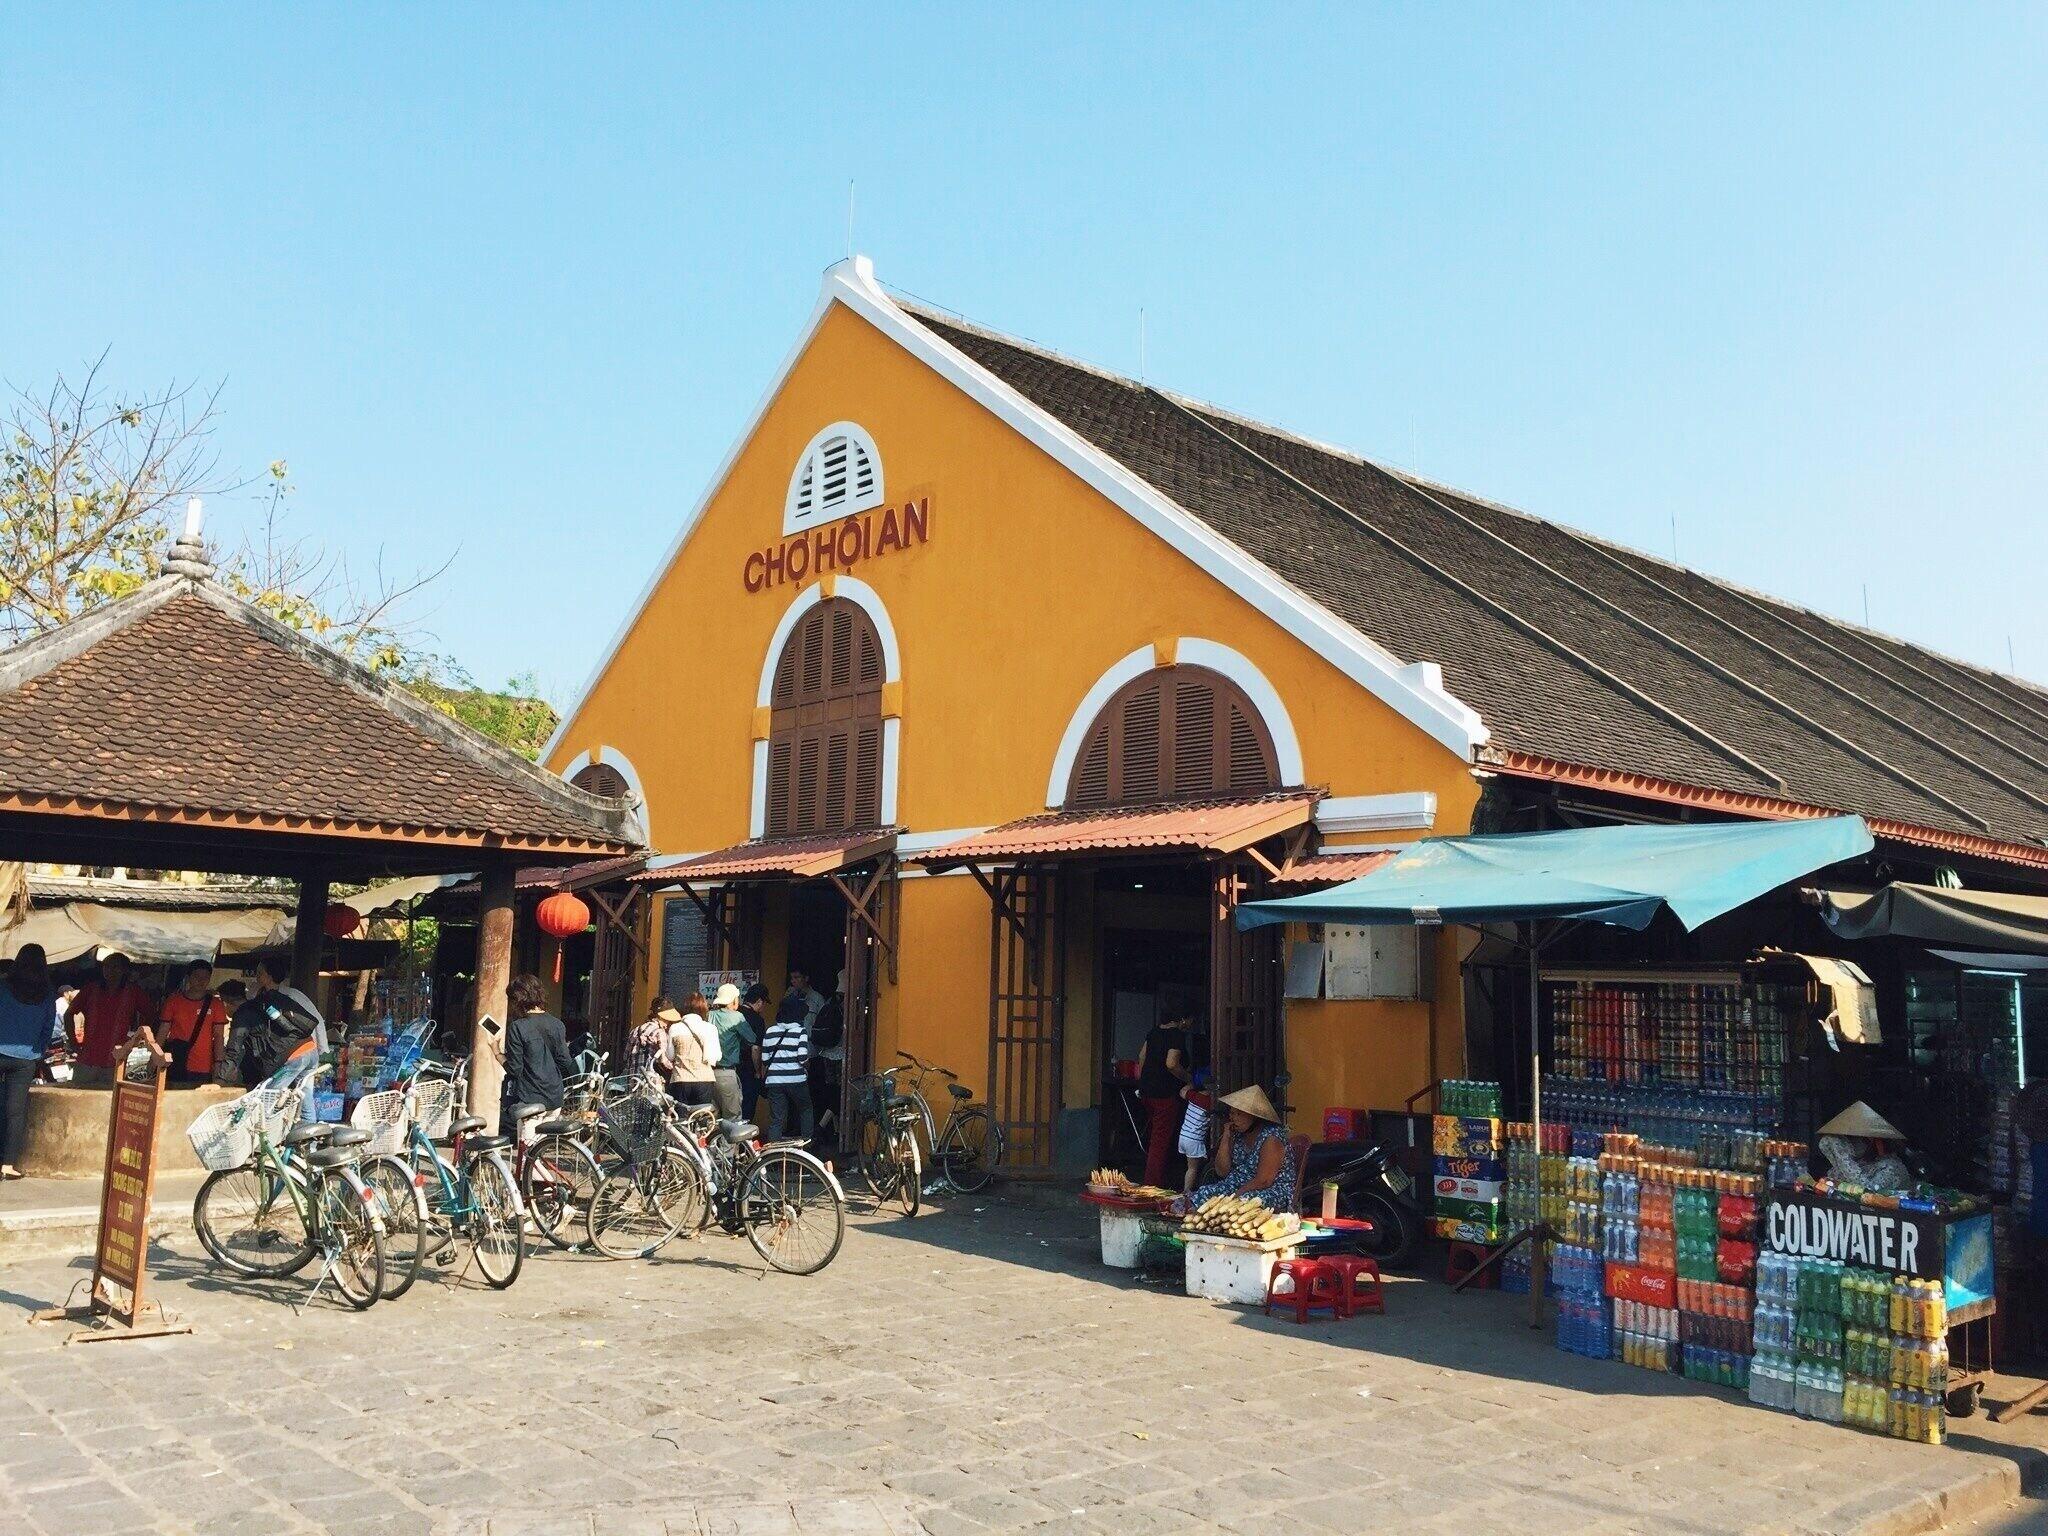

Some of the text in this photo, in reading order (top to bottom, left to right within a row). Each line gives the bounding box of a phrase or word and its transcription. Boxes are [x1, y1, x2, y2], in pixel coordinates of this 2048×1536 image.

[743, 497, 930, 593] CHỢ HỘI AN
[1447, 1160, 1480, 1178] Tiger
